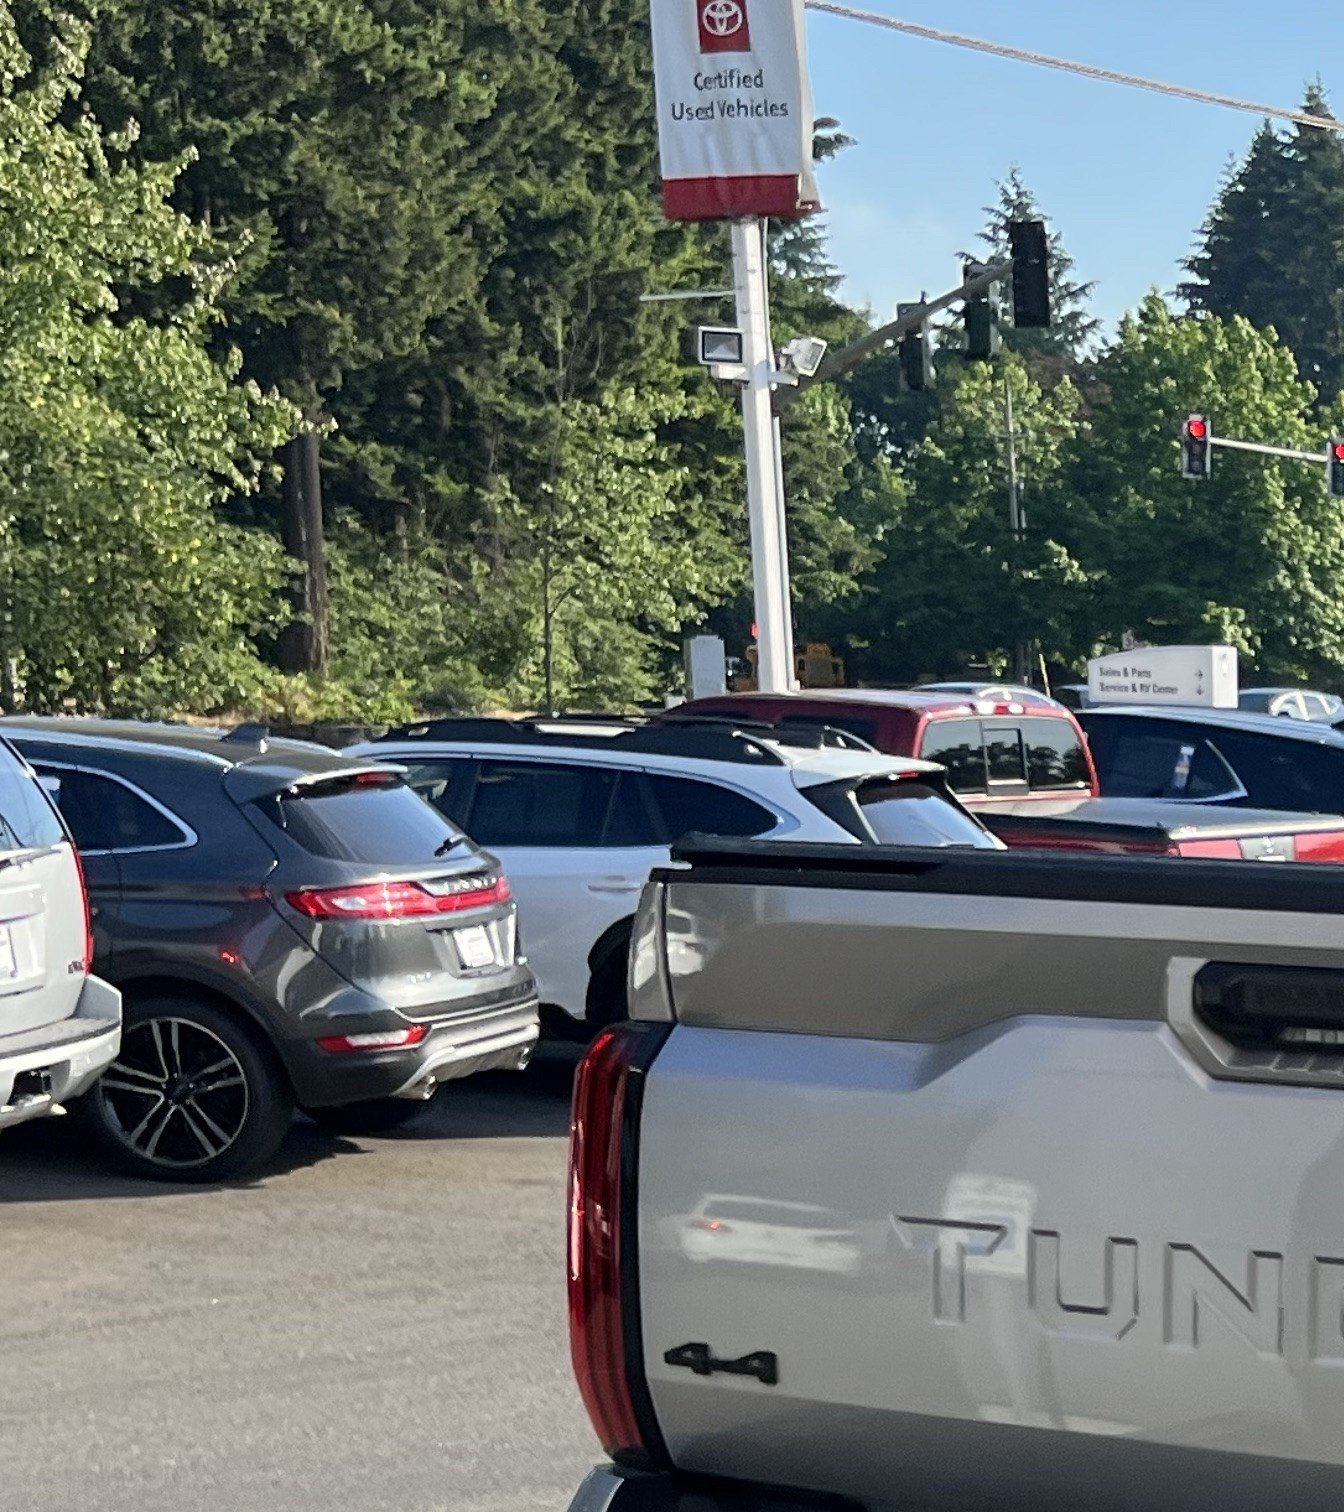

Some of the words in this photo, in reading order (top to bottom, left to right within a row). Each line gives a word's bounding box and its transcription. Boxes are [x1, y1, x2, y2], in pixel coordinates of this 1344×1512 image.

[694, 68, 764, 91] Certified
[671, 101, 715, 121] Used
[717, 98, 789, 119] Vehicles
